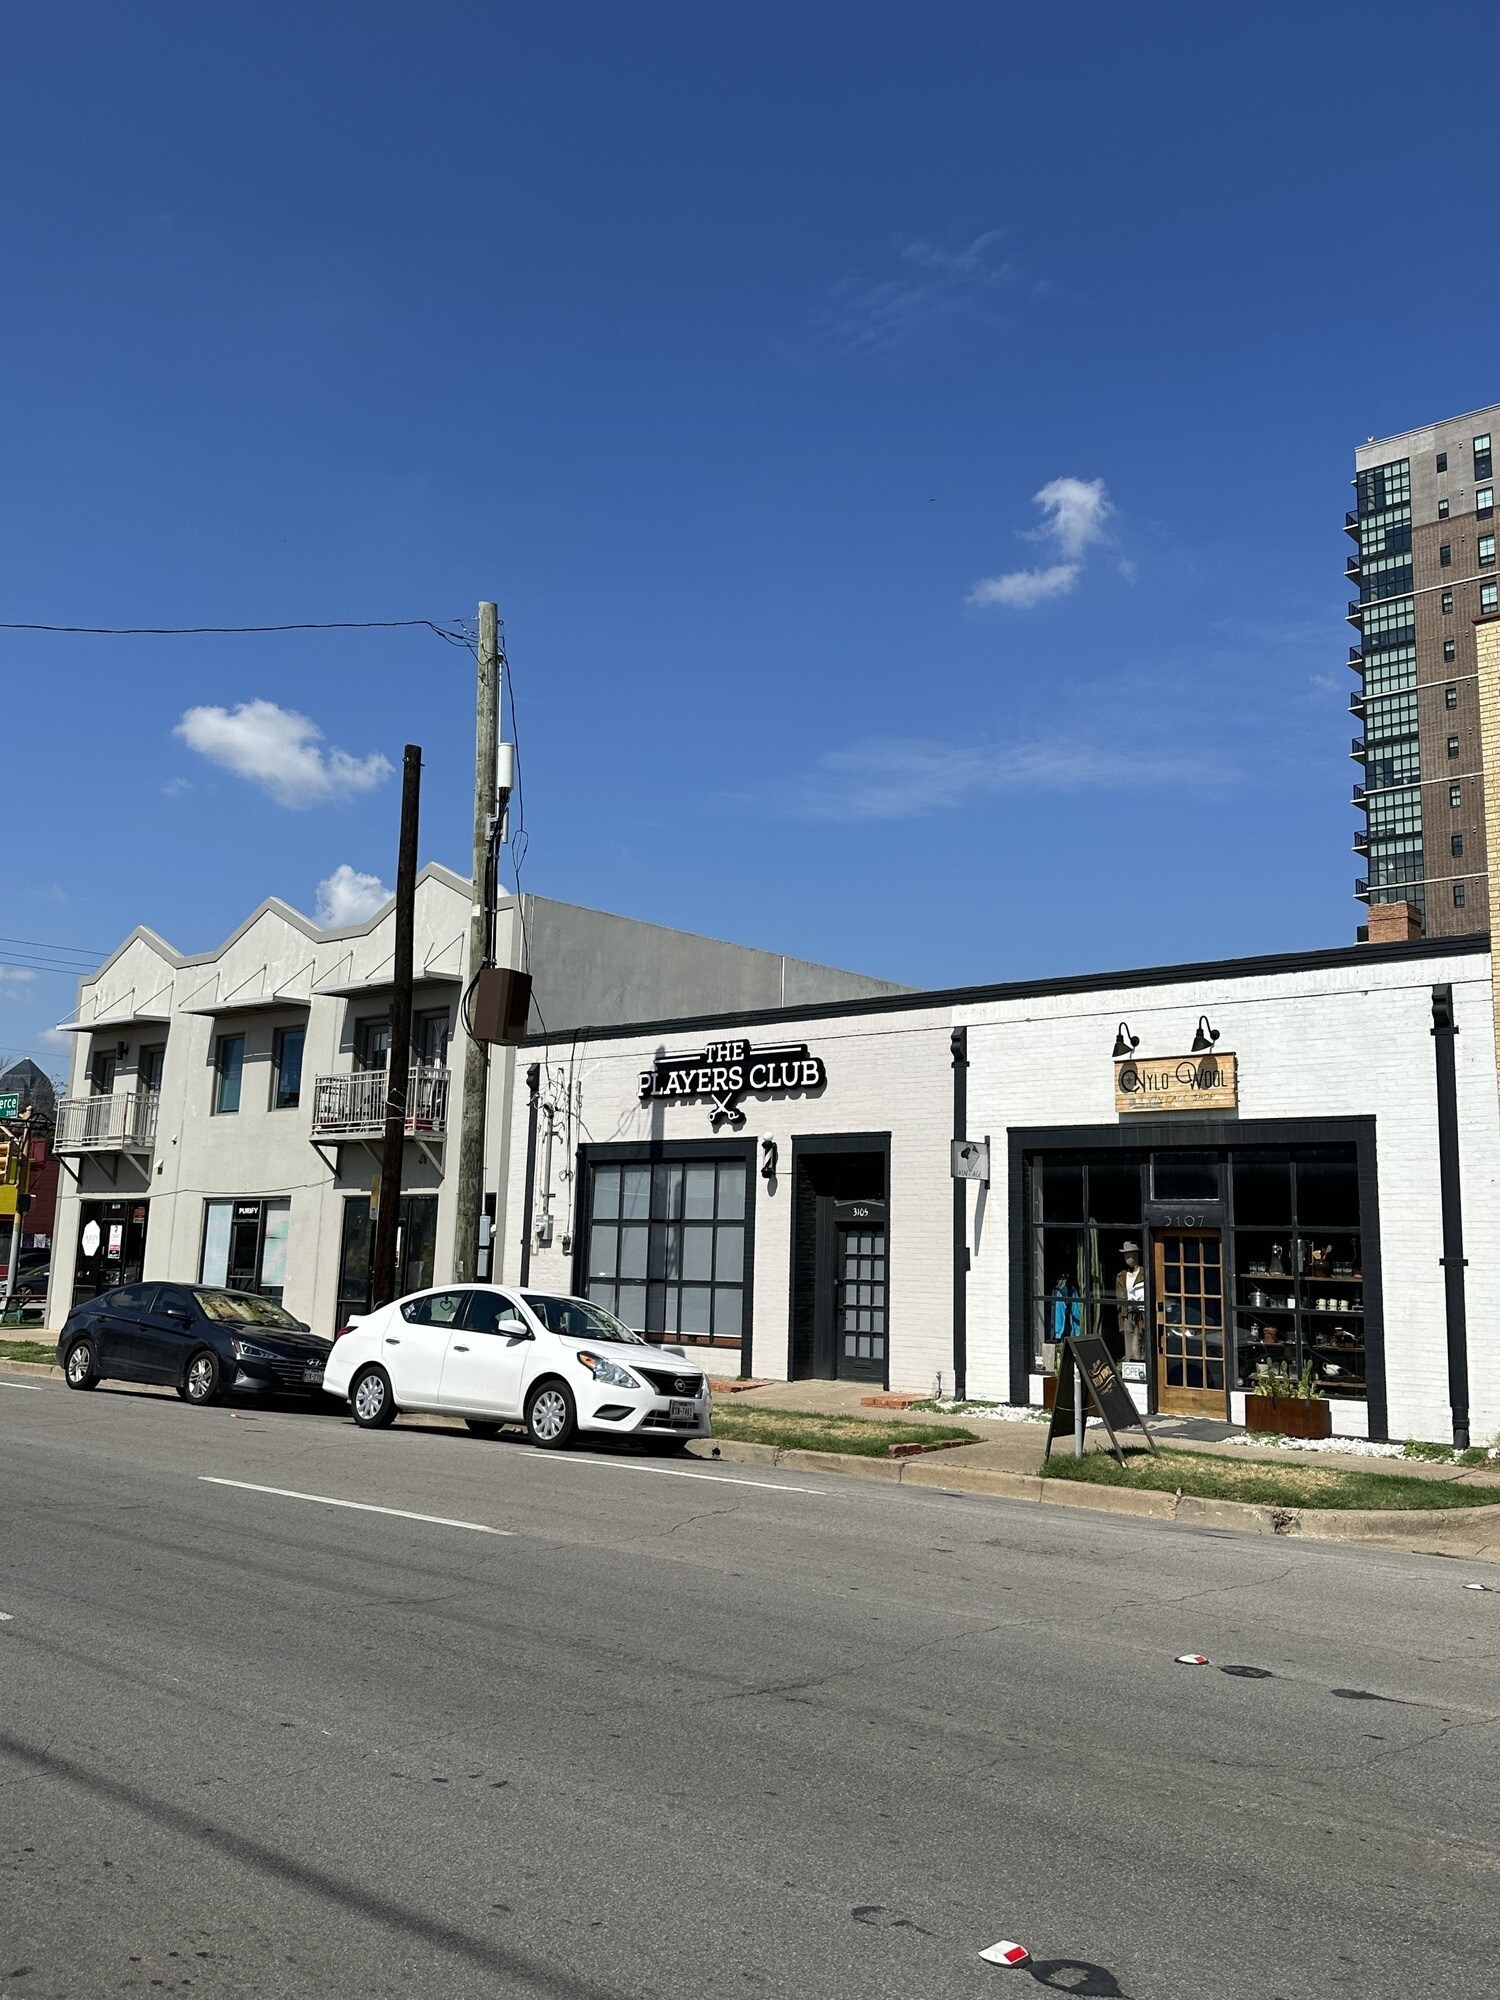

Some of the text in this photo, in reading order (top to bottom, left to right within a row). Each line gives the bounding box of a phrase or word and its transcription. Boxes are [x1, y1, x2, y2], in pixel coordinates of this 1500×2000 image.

[705, 1041, 744, 1064] THE
[637, 1060, 820, 1097] PLAYERS CLUB
[1193, 1093, 1216, 1102] SHOP
[238, 1207, 259, 1215] PURIFY
[853, 1207, 869, 1217] 3105
[1164, 1215, 1205, 1228] 3107
